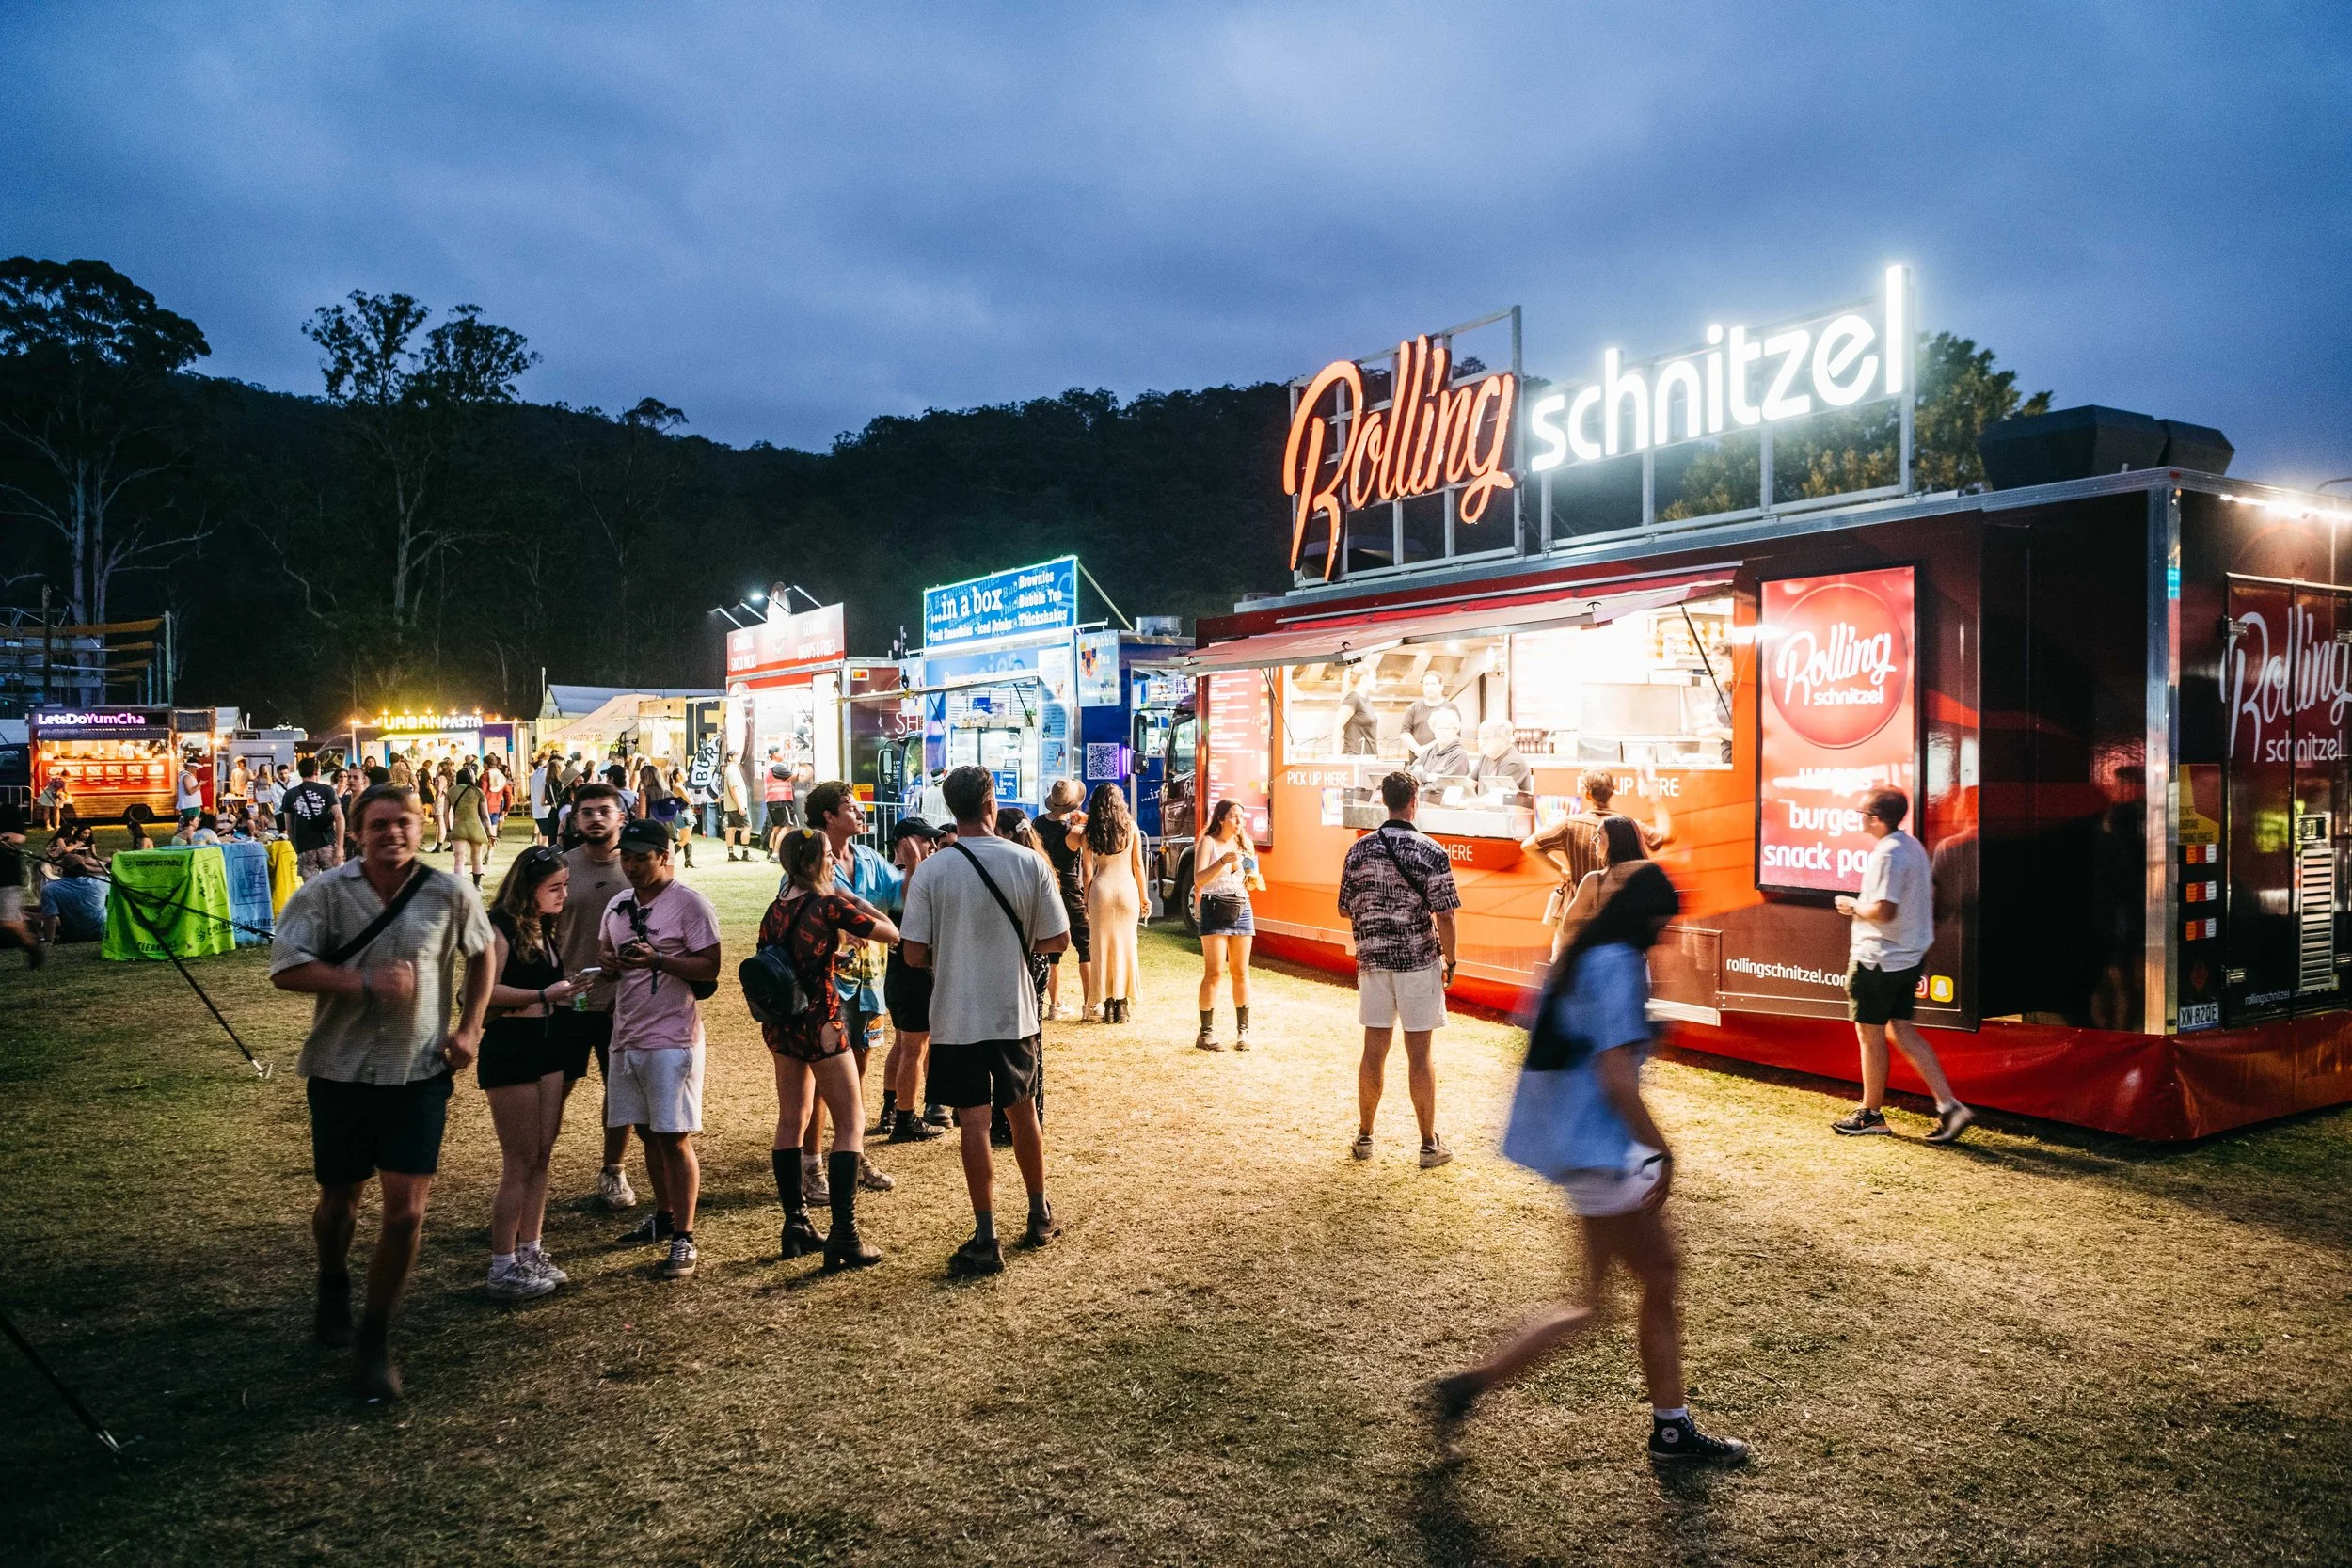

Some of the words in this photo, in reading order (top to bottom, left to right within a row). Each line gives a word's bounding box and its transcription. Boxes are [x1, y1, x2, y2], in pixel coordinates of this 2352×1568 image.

[1530, 263, 1904, 473] schnitzel
[1283, 333, 1514, 583] Rolling
[1019, 571, 1055, 590] Brownies
[960, 594, 971, 618] a
[972, 585, 1004, 615] box
[1018, 591, 1047, 609] Bubble
[1047, 588, 1063, 603] Tea
[1018, 609, 1068, 628] Thickshakes
[930, 627, 944, 642] Fruit
[944, 626, 974, 641] Smoothies
[977, 621, 991, 635] Iced
[992, 617, 1013, 633] Drinks
[1090, 632, 1117, 648] Bubble
[1097, 653, 1111, 665] Tea
[1776, 622, 1897, 705] Rolling
[2218, 603, 2352, 763] Rolling
[1813, 686, 1883, 705] schnitzel
[38, 712, 145, 725] LetsDoYumCha
[383, 715, 441, 730] URBAN
[441, 715, 483, 729] PASTA
[2266, 729, 2342, 763] schnitzel
[1287, 770, 1308, 786] PICK
[1308, 770, 1323, 786] UP
[1323, 770, 1349, 786] HERE
[1638, 777, 1679, 797] HRE
[1789, 800, 1864, 837] burger
[1446, 844, 1473, 862] HERE
[1763, 841, 1832, 871] snack
[135, 859, 183, 868] COMPOSTABLE
